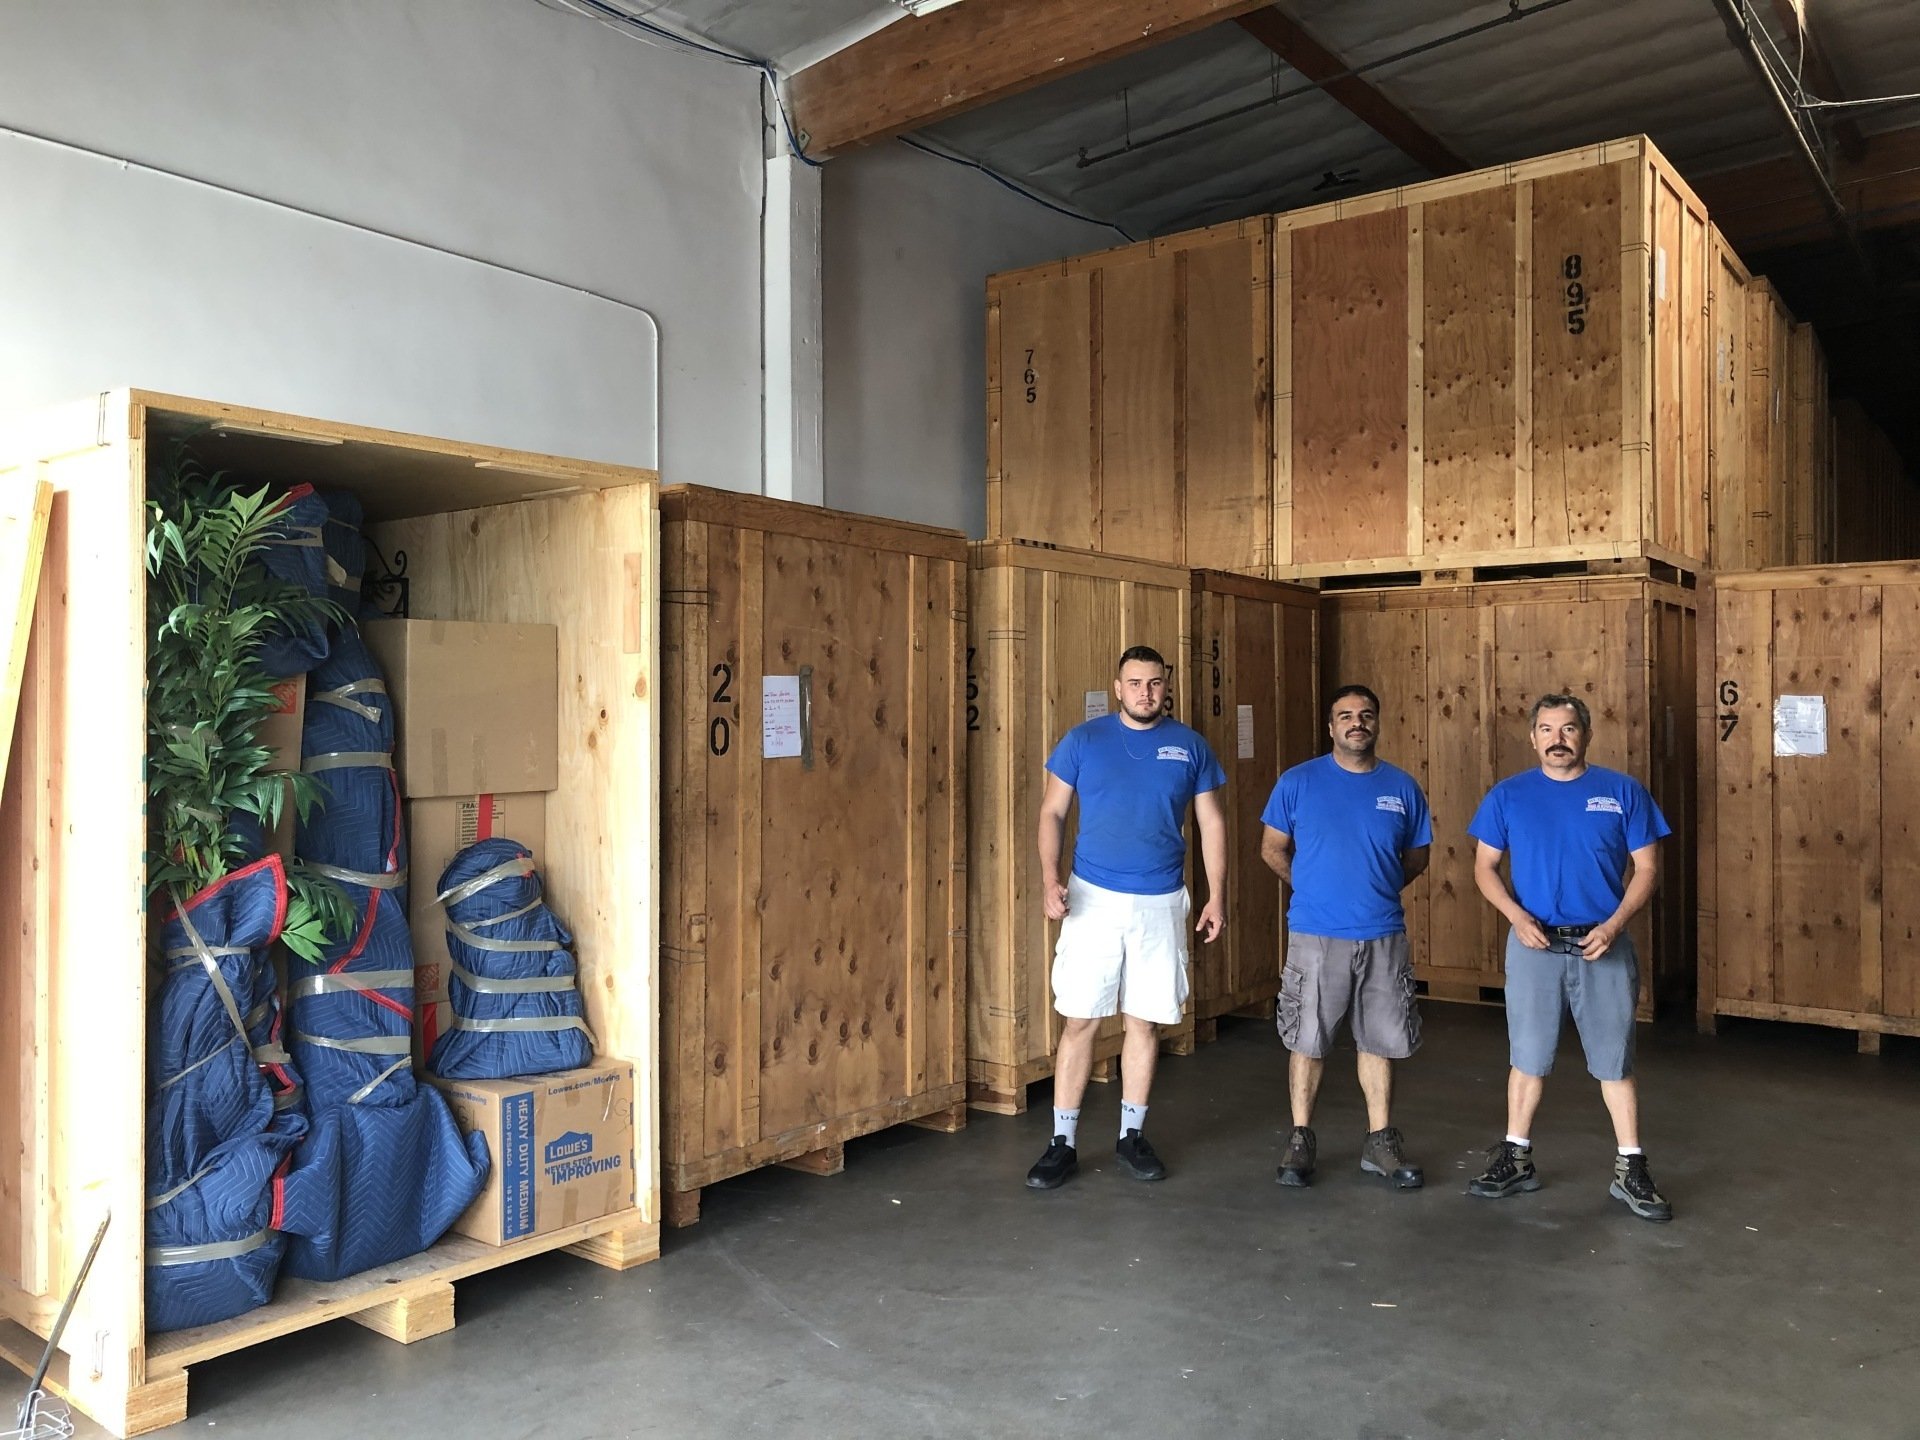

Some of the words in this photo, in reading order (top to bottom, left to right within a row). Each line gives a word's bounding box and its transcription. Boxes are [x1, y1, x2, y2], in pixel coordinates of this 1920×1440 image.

[1564, 254, 1586, 335] 895
[1024, 348, 1037, 404] 765
[1212, 639, 1221, 717] 598
[710, 663, 732, 757] 20
[1719, 680, 1739, 742] 67
[518, 1098, 529, 1140] HEAVY
[518, 1143, 529, 1176] DUTY
[544, 1161, 571, 1176] NEVER
[572, 1155, 593, 1168] STOP
[549, 1139, 588, 1160] LOWE'S
[551, 1154, 622, 1186] IMPROVING
[519, 1179, 529, 1231] MEDIUM
